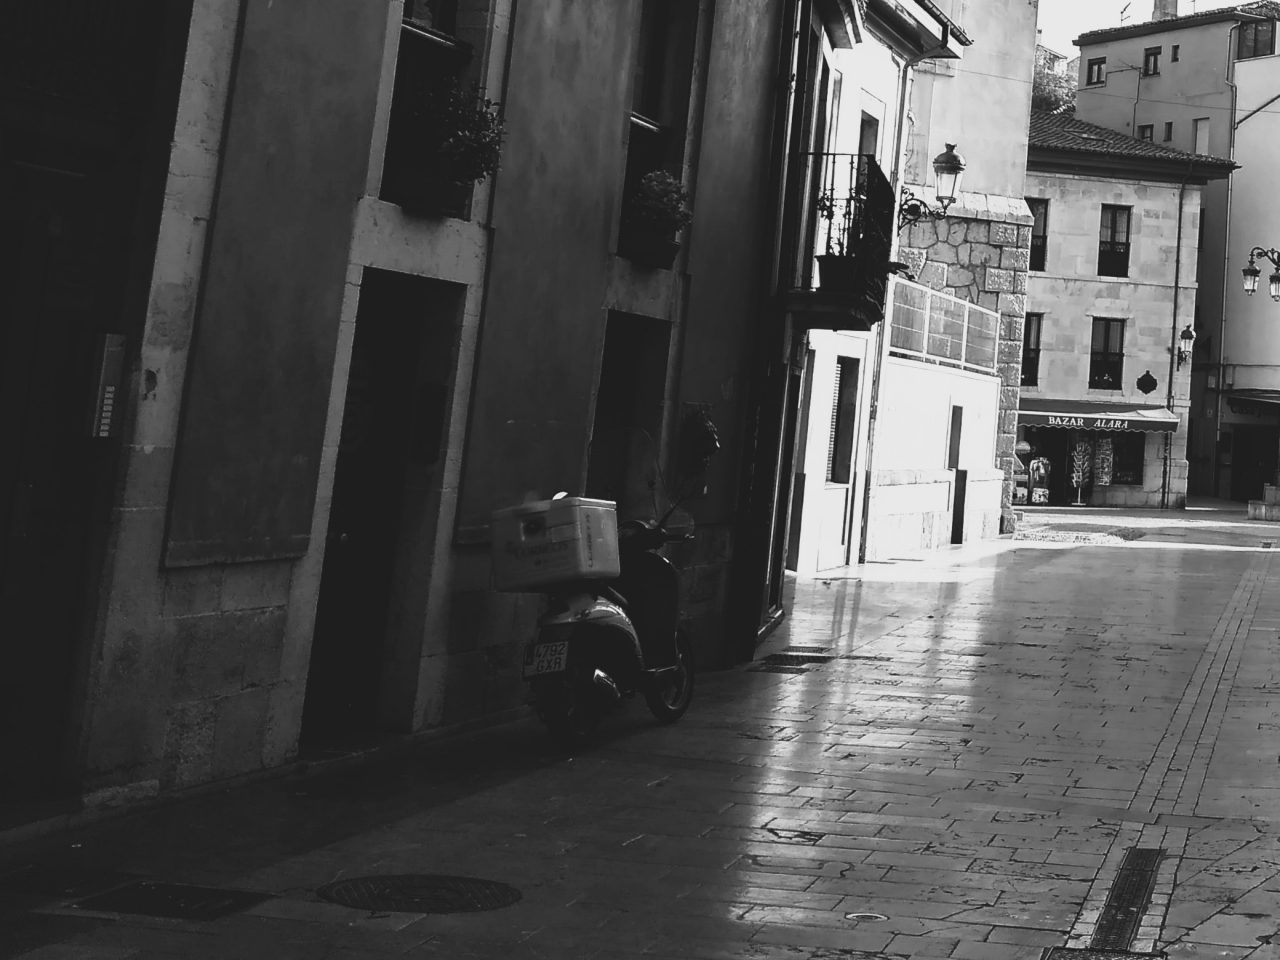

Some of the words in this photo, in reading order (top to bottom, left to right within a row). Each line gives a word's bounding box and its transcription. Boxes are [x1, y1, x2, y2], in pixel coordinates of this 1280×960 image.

[1048, 416, 1084, 426] BAZAR
[1093, 419, 1128, 429] ALARA
[535, 643, 565, 658] 4792
[537, 657, 562, 672] GXR
